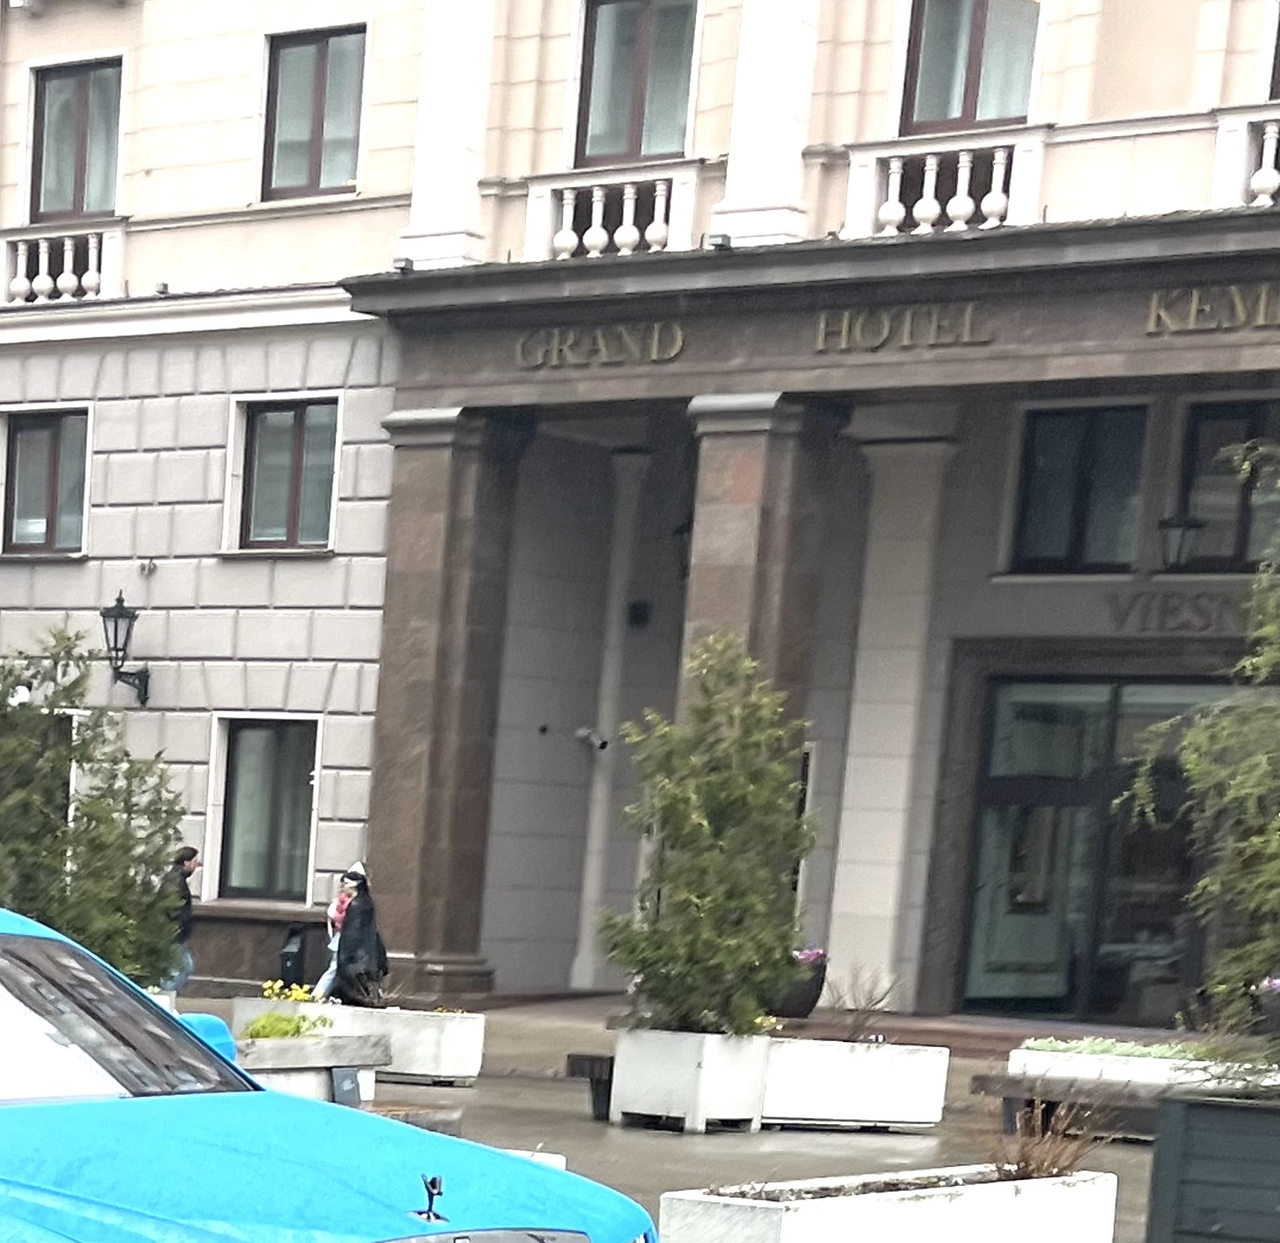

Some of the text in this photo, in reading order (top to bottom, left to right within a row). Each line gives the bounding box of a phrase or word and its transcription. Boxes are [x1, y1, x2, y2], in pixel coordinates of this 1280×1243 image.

[517, 285, 1280, 370] GRAND HOTEL KEM
[1106, 591, 1250, 632] VIESN
